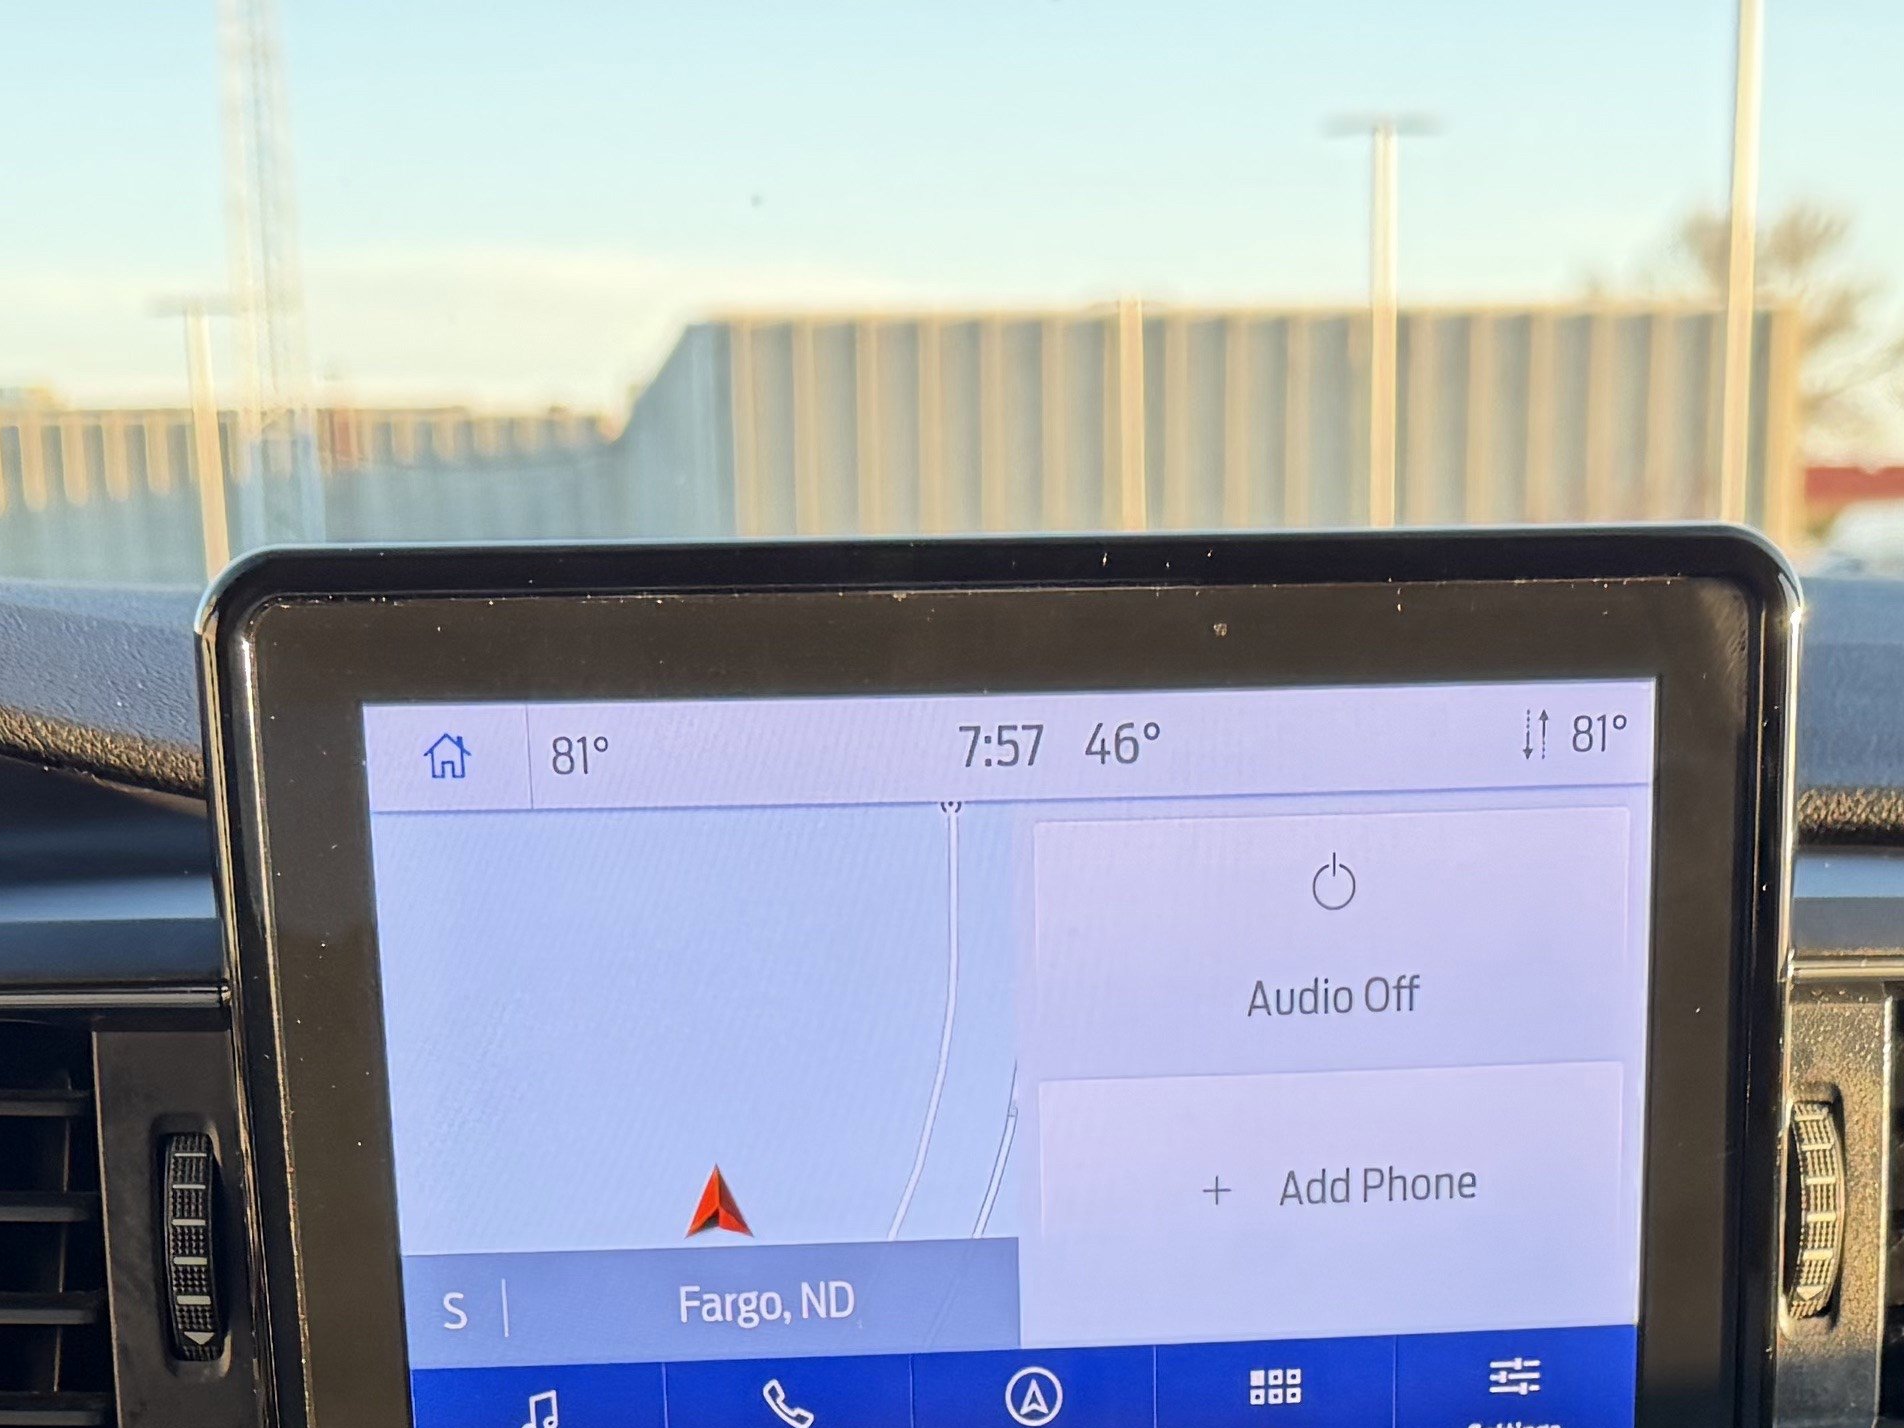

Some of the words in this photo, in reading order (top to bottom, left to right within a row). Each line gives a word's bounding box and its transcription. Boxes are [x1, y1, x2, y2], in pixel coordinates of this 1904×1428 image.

[958, 723, 1044, 770] 7:57
[1085, 722, 1162, 766] 46°
[1571, 713, 1628, 753] 81°
[551, 735, 610, 777] 81°
[1247, 976, 1354, 1018] Audio
[1364, 974, 1421, 1014] Off
[1278, 1167, 1350, 1206] Add
[1362, 1165, 1478, 1204] Phone
[443, 1291, 468, 1330] S
[678, 1285, 792, 1329] Fargo,
[801, 1280, 855, 1320] ND
